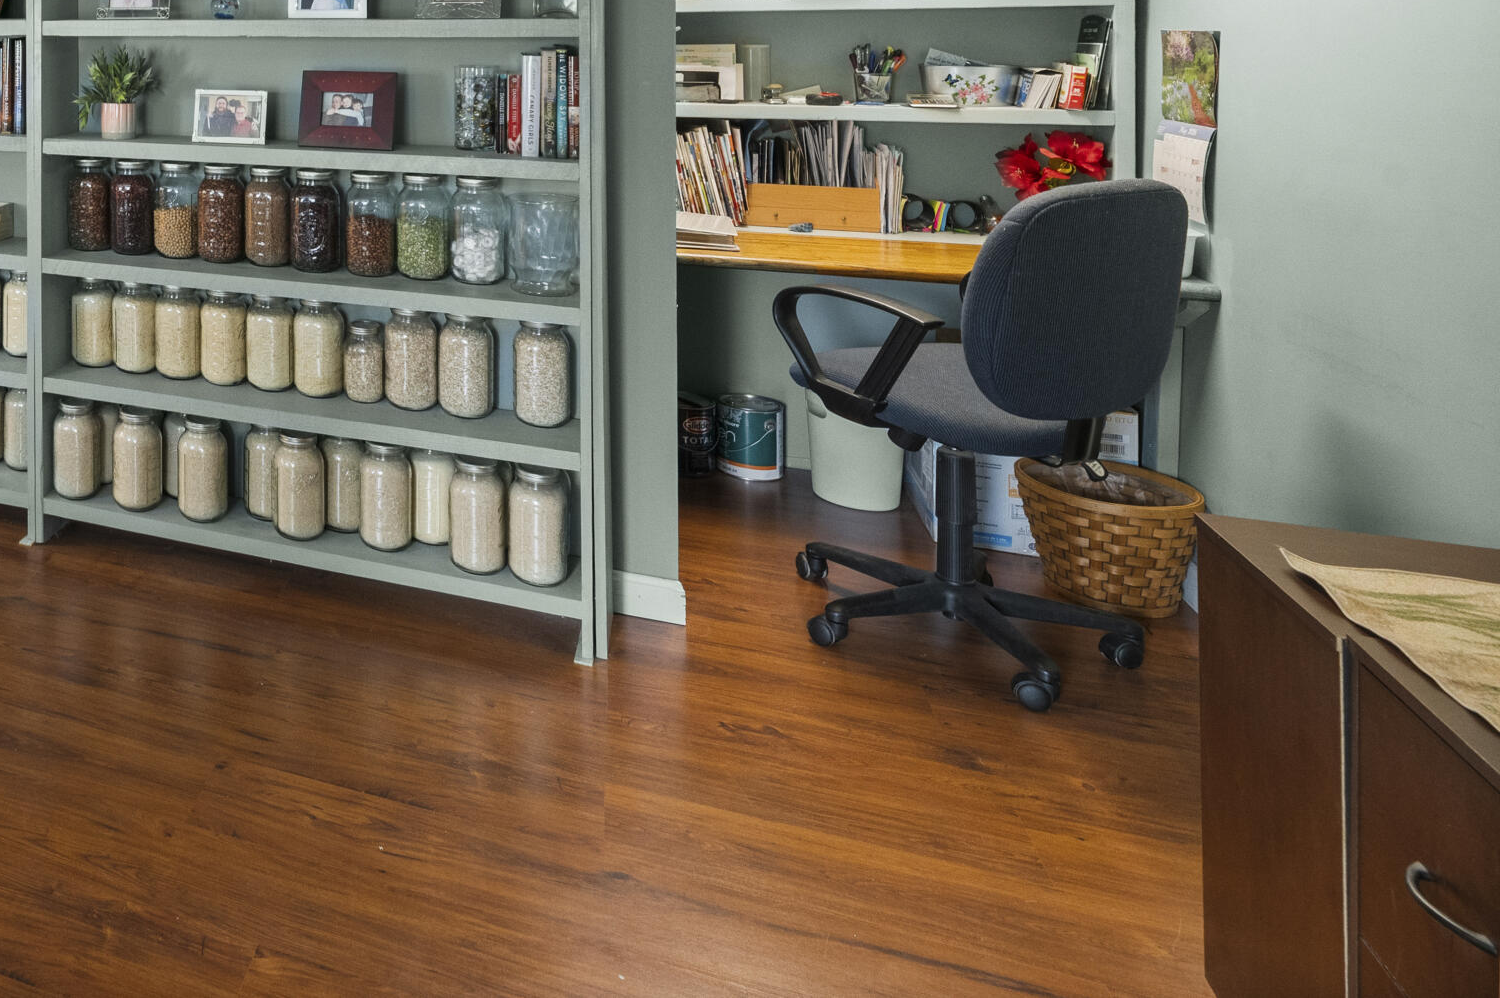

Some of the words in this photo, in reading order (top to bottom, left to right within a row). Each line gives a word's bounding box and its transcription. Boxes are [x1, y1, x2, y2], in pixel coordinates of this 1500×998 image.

[559, 65, 567, 101] WIDOW
[559, 106, 567, 122] SPY
[682, 436, 713, 445] TOTAL
